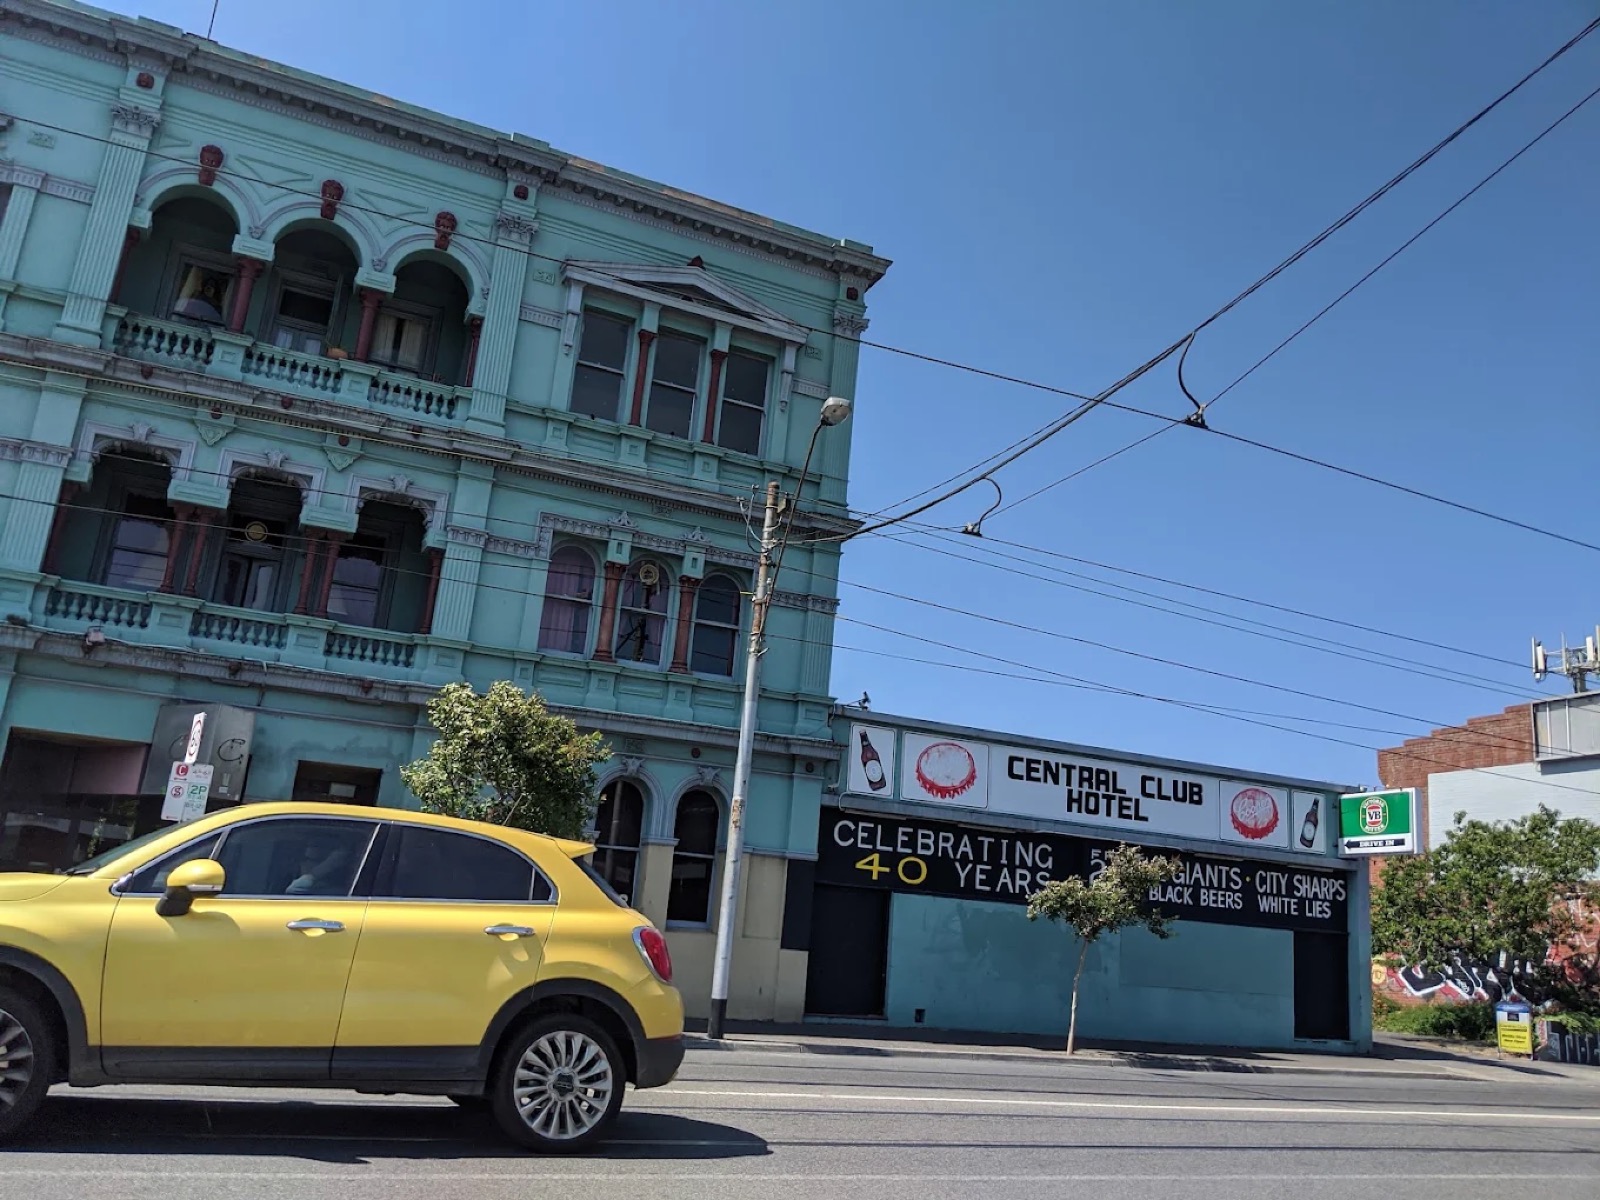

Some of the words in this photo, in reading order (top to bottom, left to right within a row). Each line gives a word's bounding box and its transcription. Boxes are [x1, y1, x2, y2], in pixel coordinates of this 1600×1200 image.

[190, 785, 208, 795] 2P
[1007, 755, 1127, 795] CENTRAL
[1140, 774, 1204, 806] CLUB
[1066, 788, 1149, 822] HOTEL
[1367, 811, 1381, 820] VB
[833, 820, 1053, 870] CELEBRATING
[1360, 840, 1385, 848] DRIVE
[1385, 839, 1395, 847] IN
[855, 853, 928, 885] 40
[1149, 885, 1194, 906] BLACK
[1200, 888, 1243, 910] BEERS
[1257, 894, 1299, 916] WHITE
[1305, 900, 1332, 919] LIES
[1255, 870, 1289, 895] CITY
[1293, 874, 1347, 902] SHARPS
